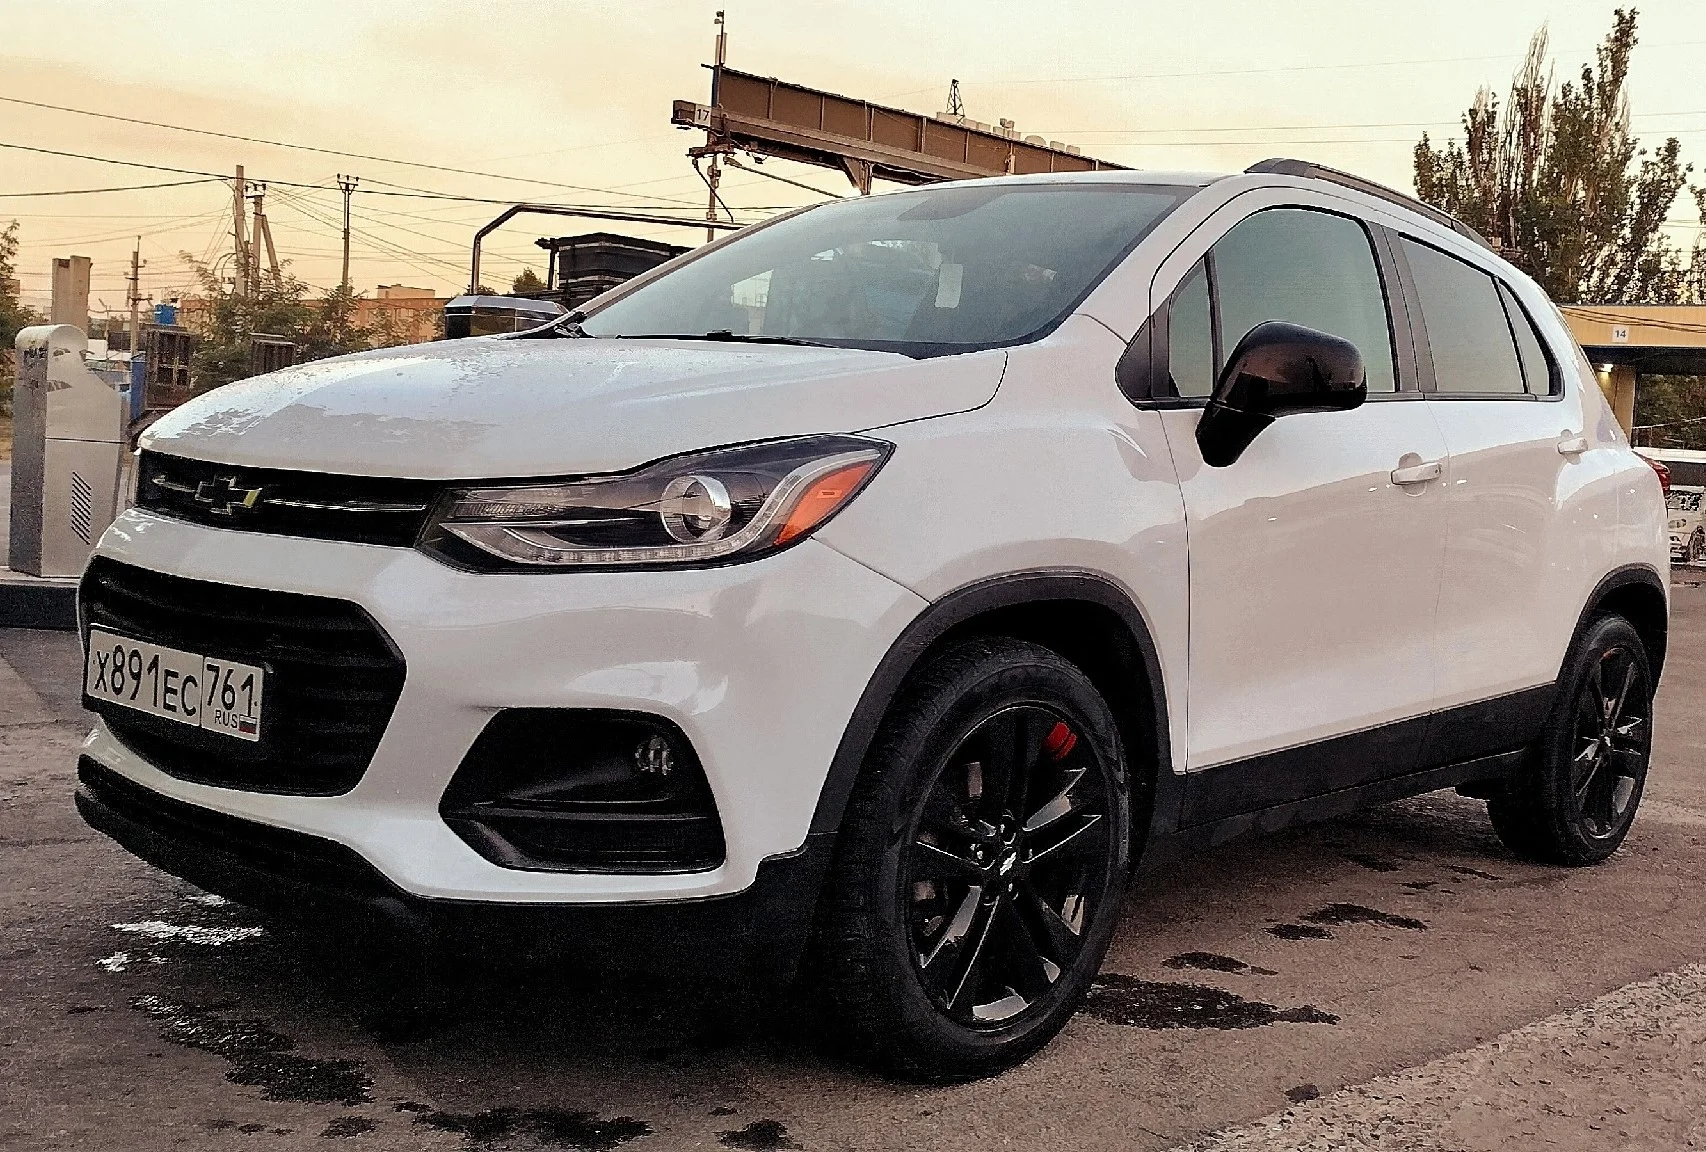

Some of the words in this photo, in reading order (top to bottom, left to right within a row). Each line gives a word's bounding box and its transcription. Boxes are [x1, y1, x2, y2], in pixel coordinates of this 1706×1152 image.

[697, 108, 710, 121] 17
[1615, 329, 1627, 338] 14
[206, 663, 255, 718] 761
[214, 709, 238, 729] RUS
